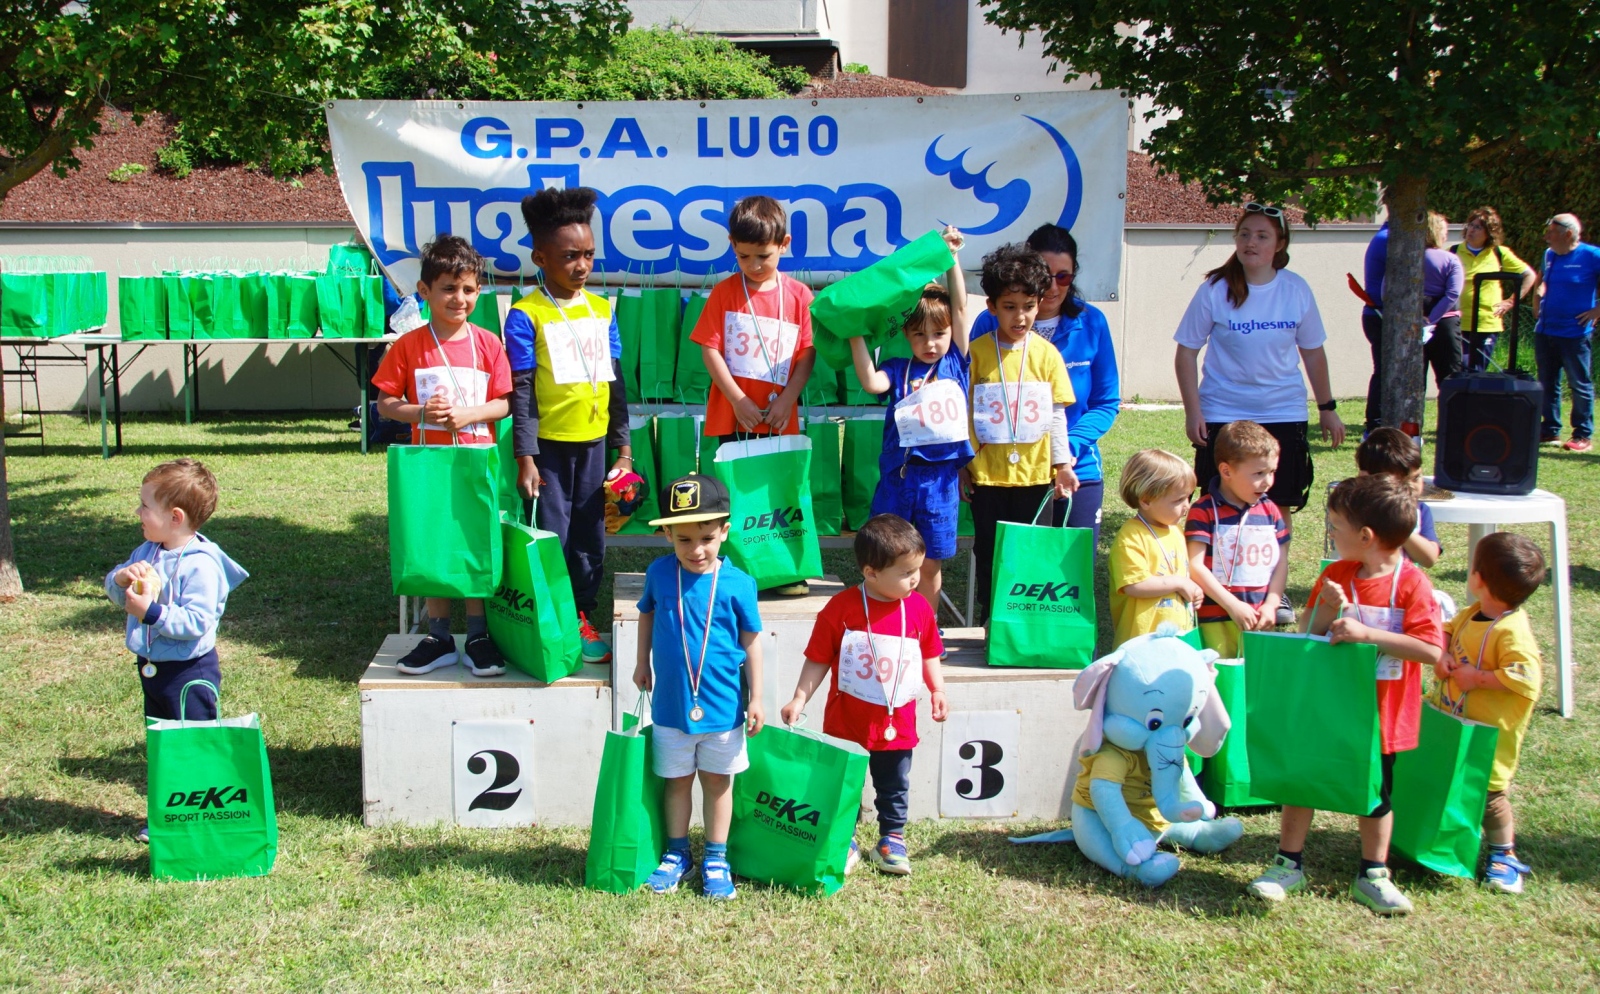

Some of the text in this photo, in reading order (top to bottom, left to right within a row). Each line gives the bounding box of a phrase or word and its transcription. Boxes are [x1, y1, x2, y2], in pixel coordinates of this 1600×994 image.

[460, 115, 838, 159] G.P.A. LUGO
[1228, 319, 1296, 335] lughesina
[734, 332, 784, 362] 379
[911, 397, 960, 428] 180
[989, 400, 1040, 425] 313
[743, 506, 804, 531] DEKA
[742, 533, 770, 546] SPORT
[1229, 543, 1273, 567] 309
[1009, 582, 1079, 602] DEKA
[1006, 602, 1080, 613] SPORT PASSION
[855, 653, 910, 684] 397
[467, 749, 523, 812] 2
[955, 739, 1005, 801] 3
[166, 786, 248, 810] DEKA
[755, 790, 821, 827] DEKA
[164, 809, 251, 823] SPORT PASSION
[753, 808, 775, 827] SPORT
[775, 820, 817, 843] PASSION
